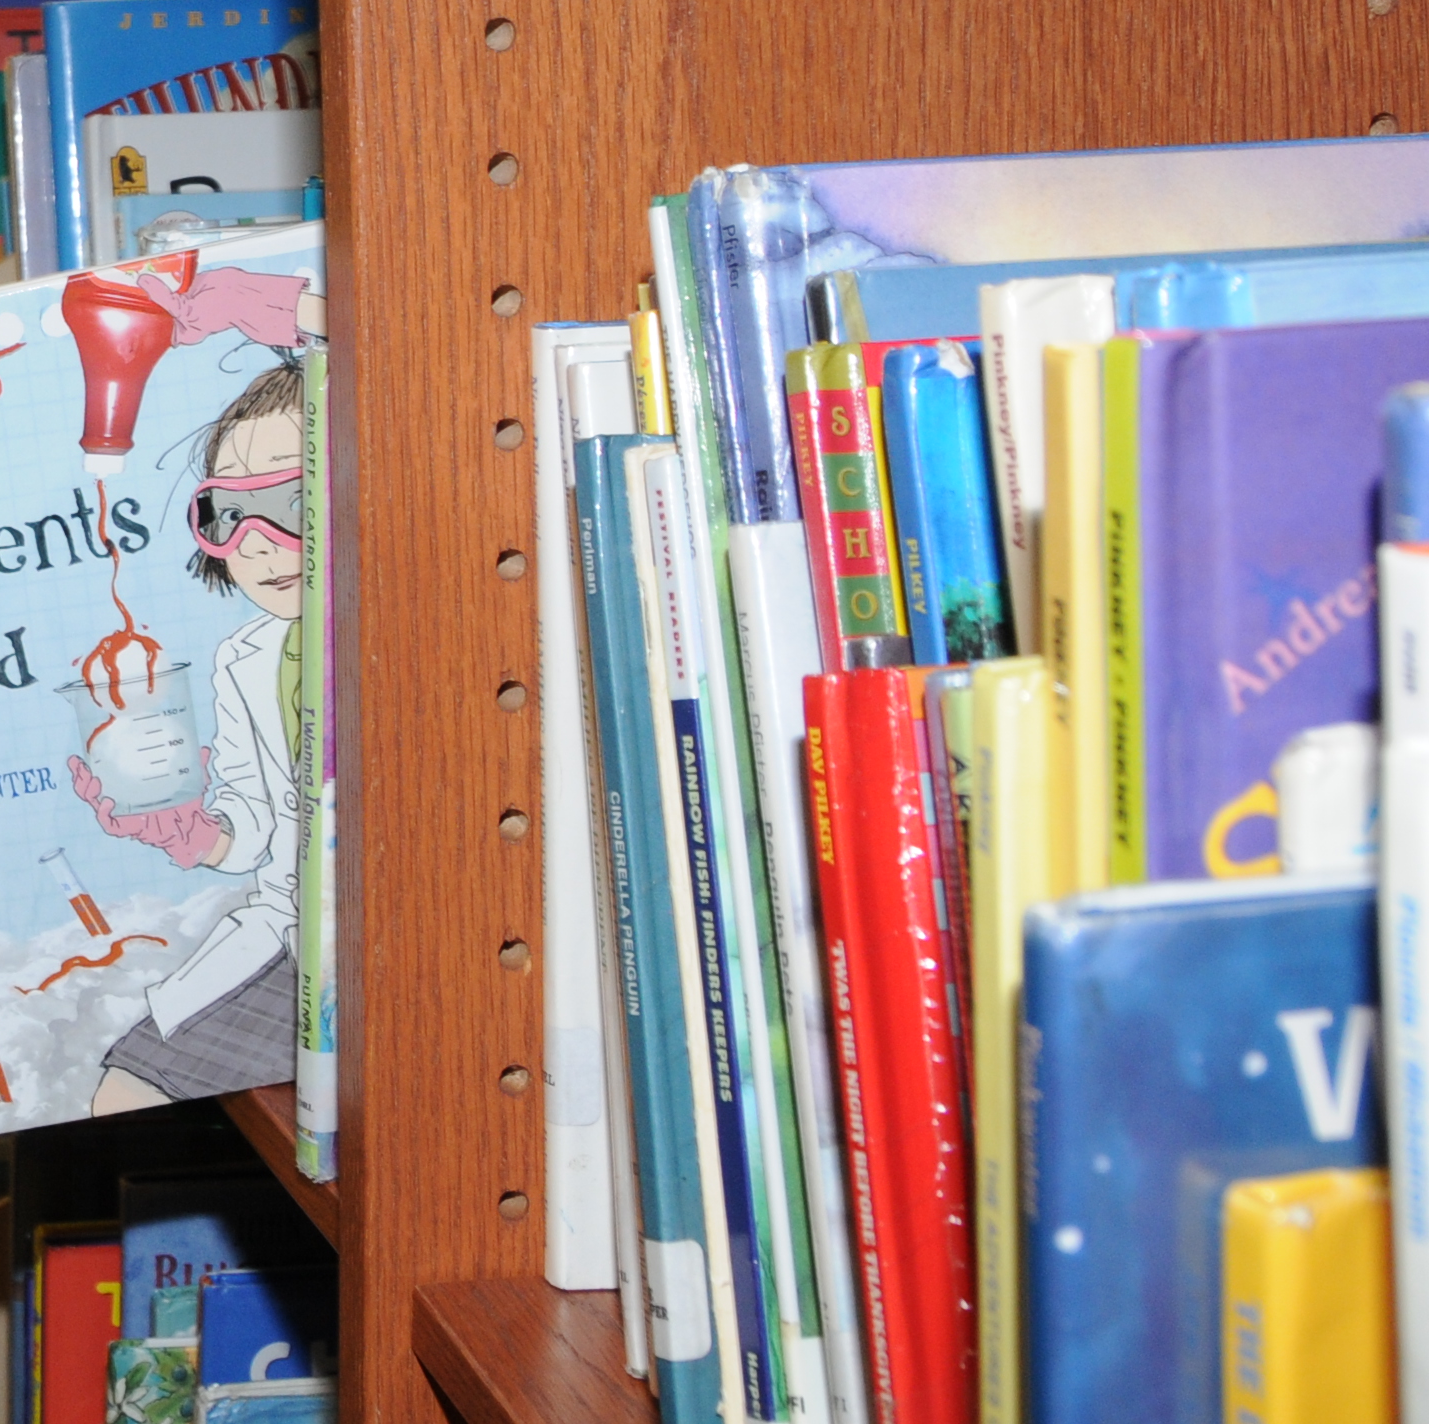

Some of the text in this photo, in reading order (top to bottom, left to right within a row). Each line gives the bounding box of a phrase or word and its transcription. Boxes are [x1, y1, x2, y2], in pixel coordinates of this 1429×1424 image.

[721, 224, 739, 289] Pfister
[795, 411, 814, 488] PILKEY
[305, 400, 317, 591] ORLOFF CATROW
[582, 517, 598, 595] Perlman
[655, 489, 685, 680] FESTIVAL READERS
[905, 537, 928, 616] PILKEY
[303, 720, 316, 788] Wanna
[681, 734, 706, 845] RAINBOW
[301, 791, 321, 862] Iguana
[808, 727, 835, 866] DAV PILKEY
[608, 790, 640, 1017] CINDERELLA PENGUIN
[701, 909, 722, 1002] FINDERS
[300, 973, 312, 1051] PUTNAM
[839, 1016, 857, 1065] THE
[710, 1008, 732, 1103] KEEPERS
[842, 1071, 865, 1144] NIGHT
[853, 1149, 877, 1247] BEFORE
